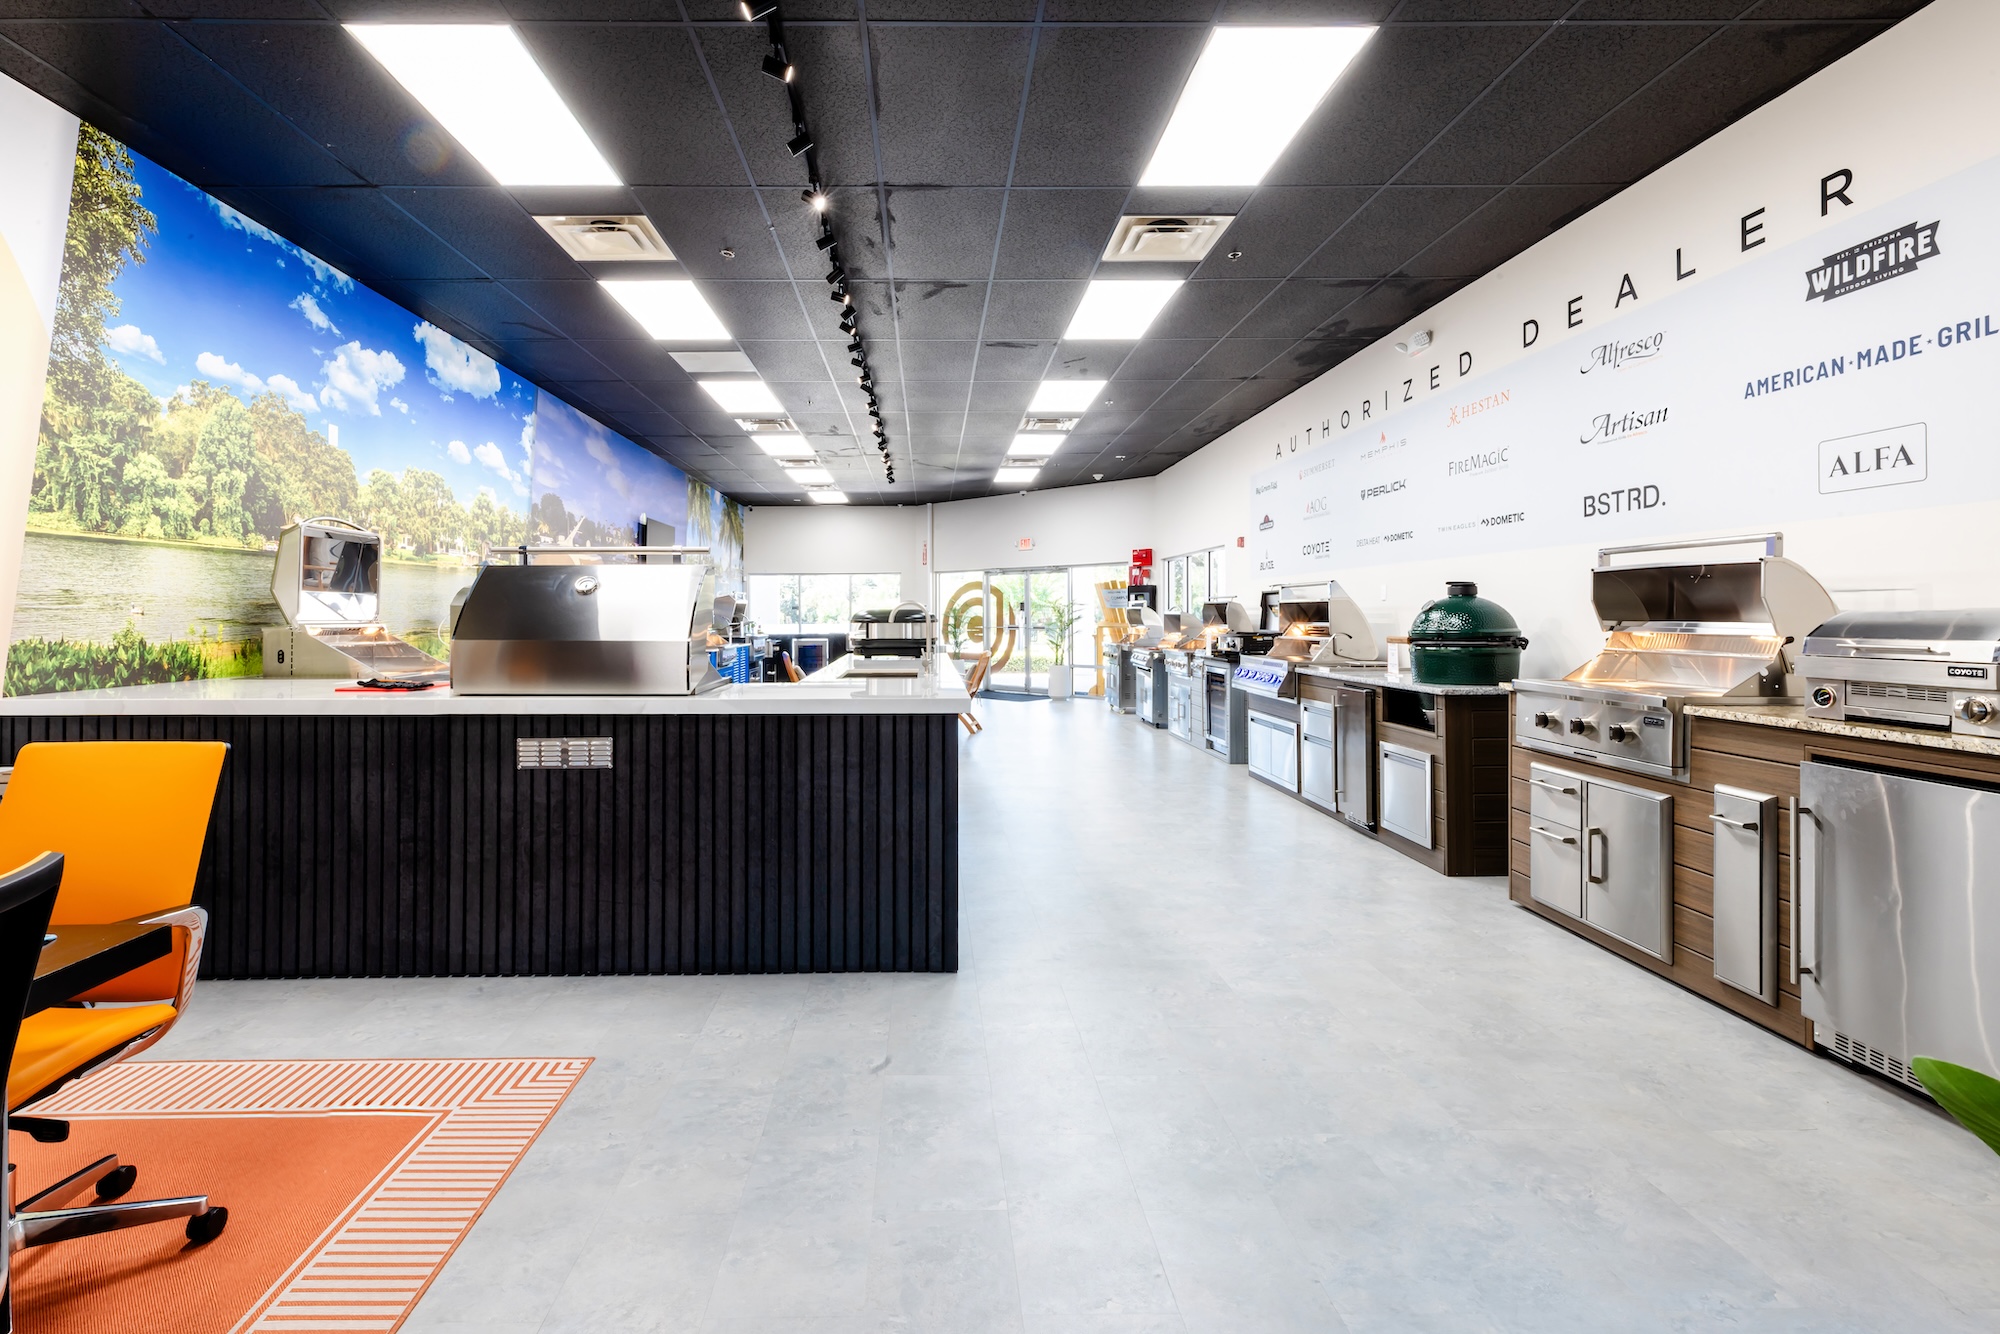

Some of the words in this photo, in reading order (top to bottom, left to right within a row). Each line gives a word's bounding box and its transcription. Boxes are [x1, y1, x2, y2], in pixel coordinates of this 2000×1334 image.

[1863, 232, 1901, 250] ARIZONA
[1811, 229, 1932, 293] WILDFIRE
[1835, 278, 1871, 295] OUTDOOR
[1874, 267, 1904, 281] LIVING
[1276, 352, 1473, 459] AUTHORIZED
[1523, 168, 1853, 348] DEALER
[1580, 332, 1663, 374] Alfresco
[1744, 356, 1845, 399] AMERICAN
[1857, 334, 1923, 370] MADE
[1461, 389, 1511, 419] HESTAN
[1580, 407, 1668, 444] Artisan
[1361, 438, 1407, 461] MEMPHIS
[1829, 444, 1915, 478] ALFA
[1367, 479, 1407, 498] PERLICK
[1584, 485, 1666, 517] BSTRD.
[1310, 497, 1327, 514] AOG
[1453, 522, 1476, 531] EAGLES
[1491, 512, 1525, 527] DOMETIC
[1303, 541, 1330, 556] COYOTE
[1390, 531, 1413, 542] DOMETIC
[1260, 560, 1274, 571] BLAZE
[1949, 668, 1983, 677] COYOTE
